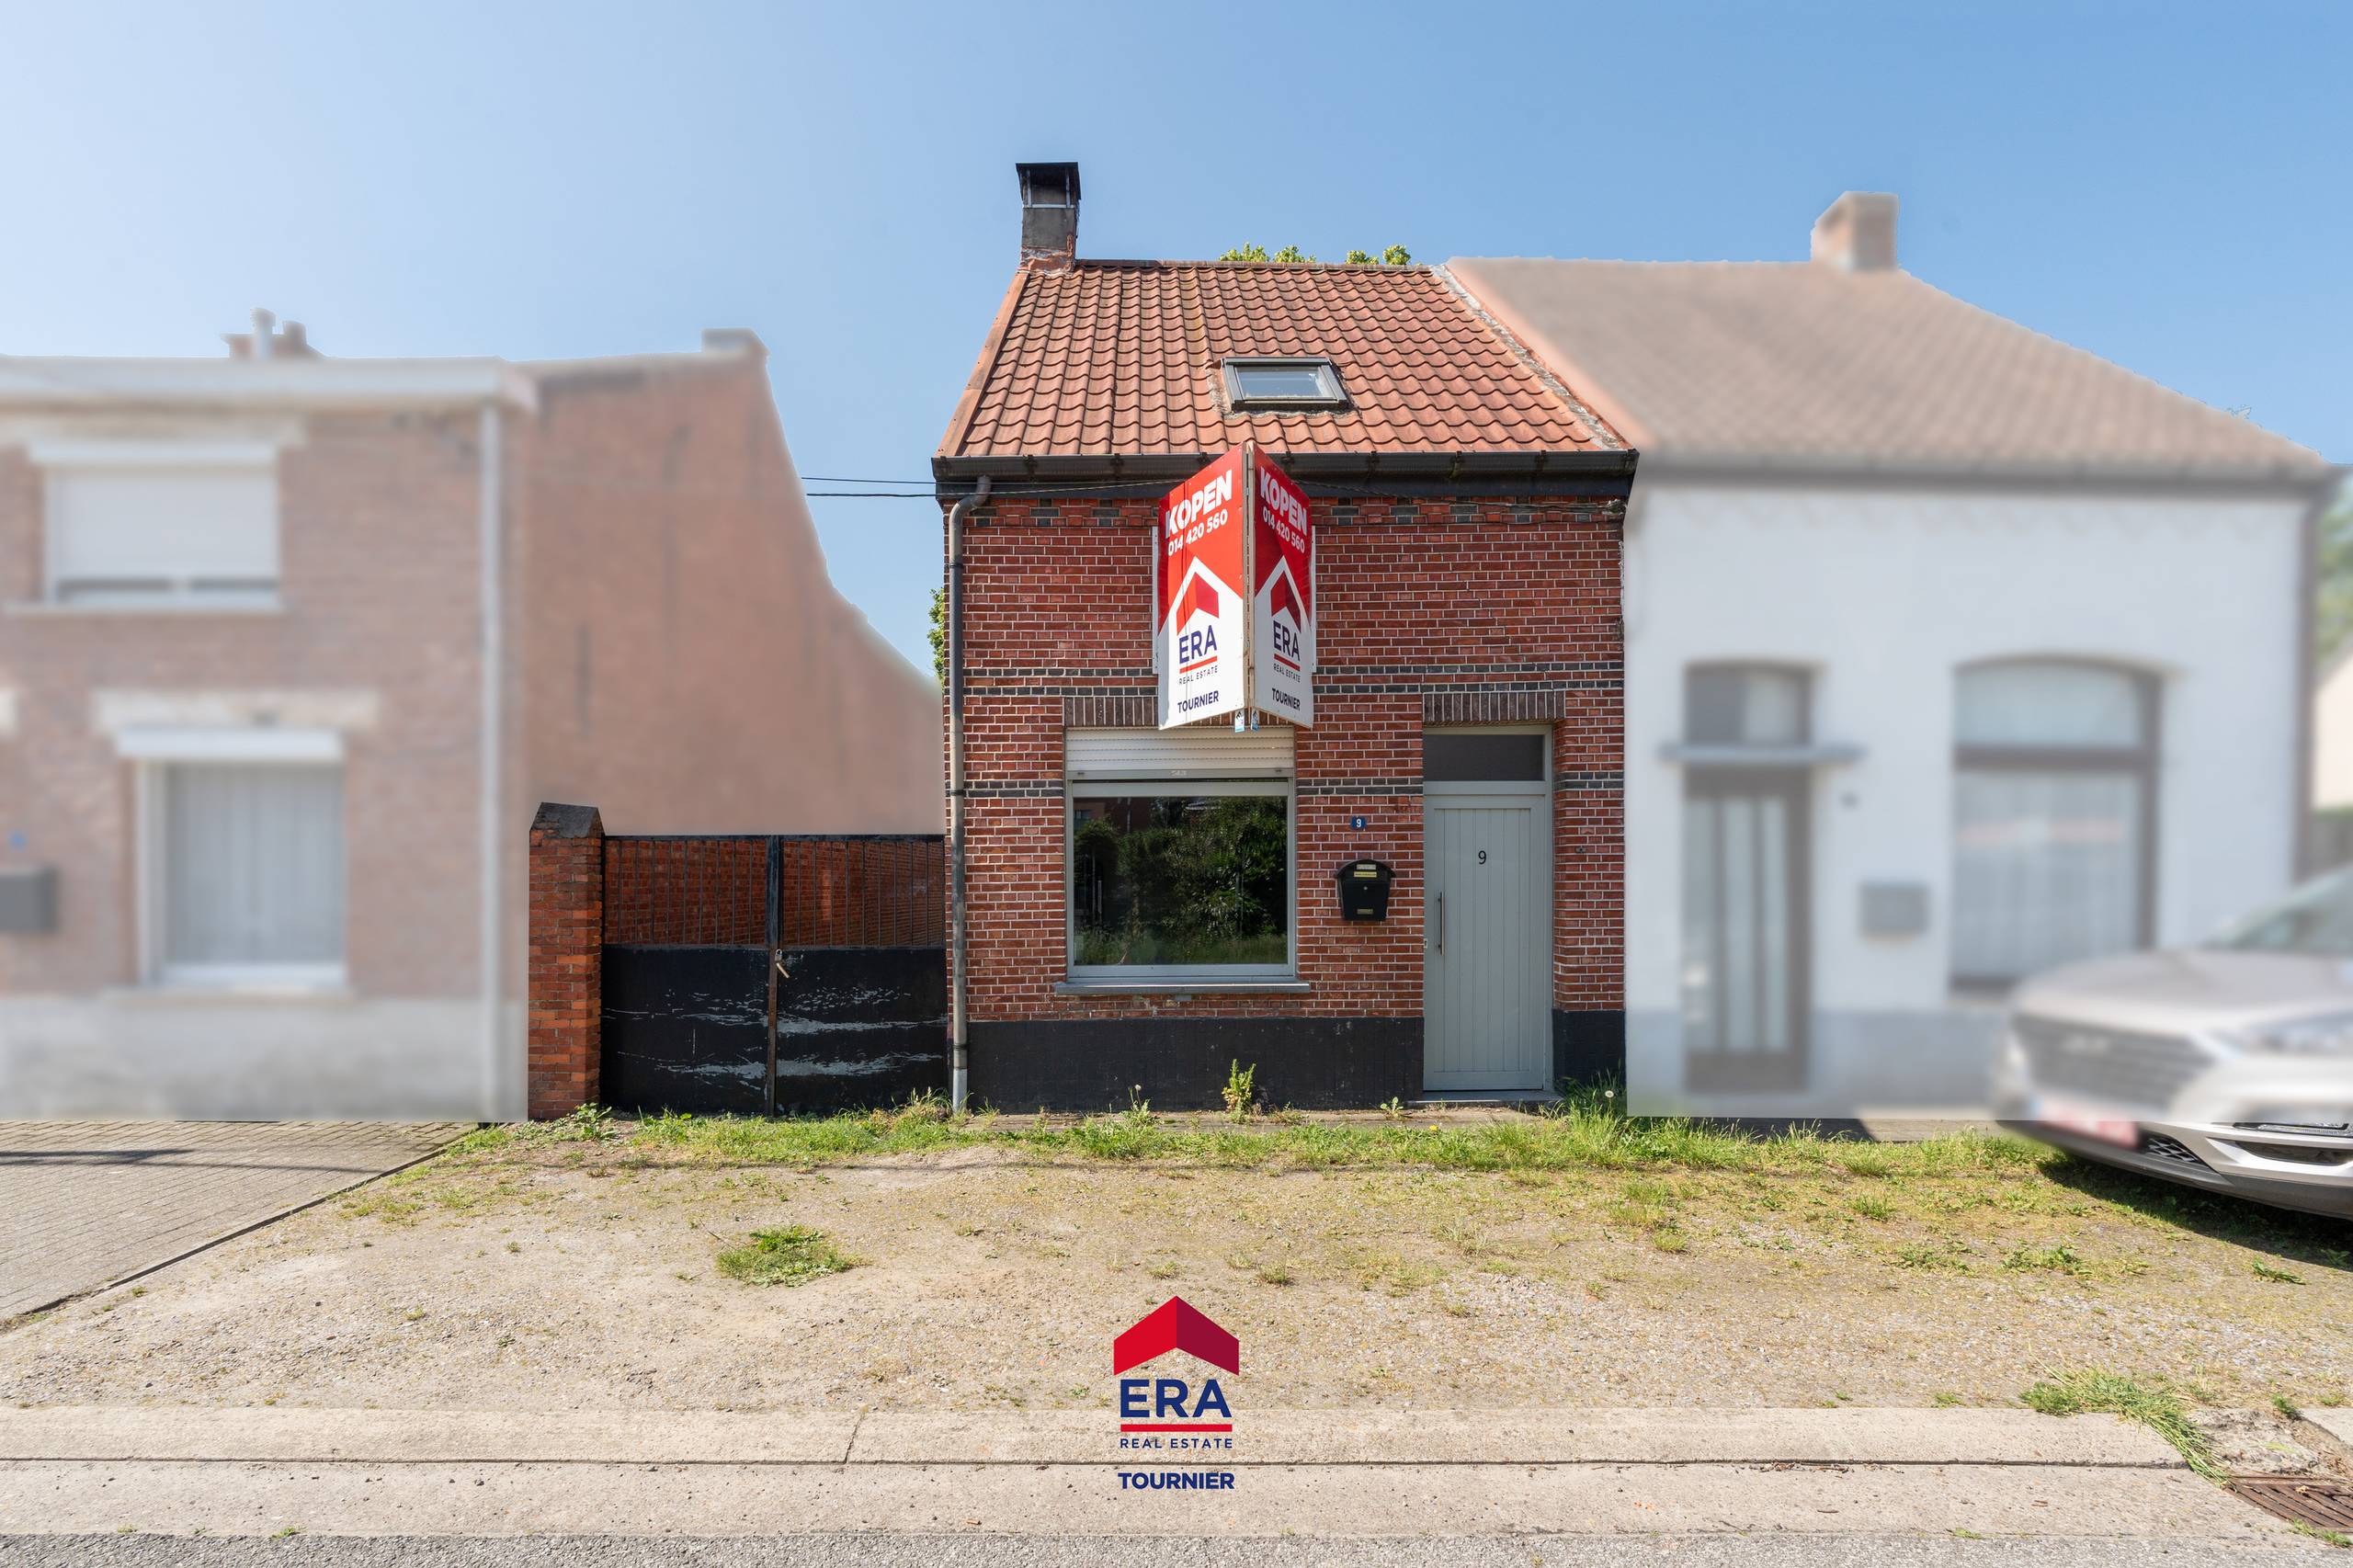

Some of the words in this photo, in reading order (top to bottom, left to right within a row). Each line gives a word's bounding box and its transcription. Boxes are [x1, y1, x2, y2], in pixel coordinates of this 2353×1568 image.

[1165, 469, 1232, 539] KOPEN
[1260, 466, 1307, 537] KOPEN
[1168, 535, 1184, 556] 014
[1186, 522, 1205, 544] 420
[1206, 508, 1228, 533] 560
[1263, 506, 1275, 529] 014
[1276, 519, 1290, 542] 420
[1291, 531, 1305, 554] 560
[1178, 624, 1218, 665] ERA
[1273, 619, 1301, 662] ERA
[1178, 675, 1194, 686] REAL
[1196, 665, 1219, 681] ESTATE
[1273, 663, 1285, 676] REAL
[1286, 668, 1301, 683] ESTATE
[1177, 690, 1220, 714] TOURNIER
[1271, 687, 1301, 711] TOURNIER
[1356, 818, 1362, 828] 9
[1478, 850, 1487, 865] 9
